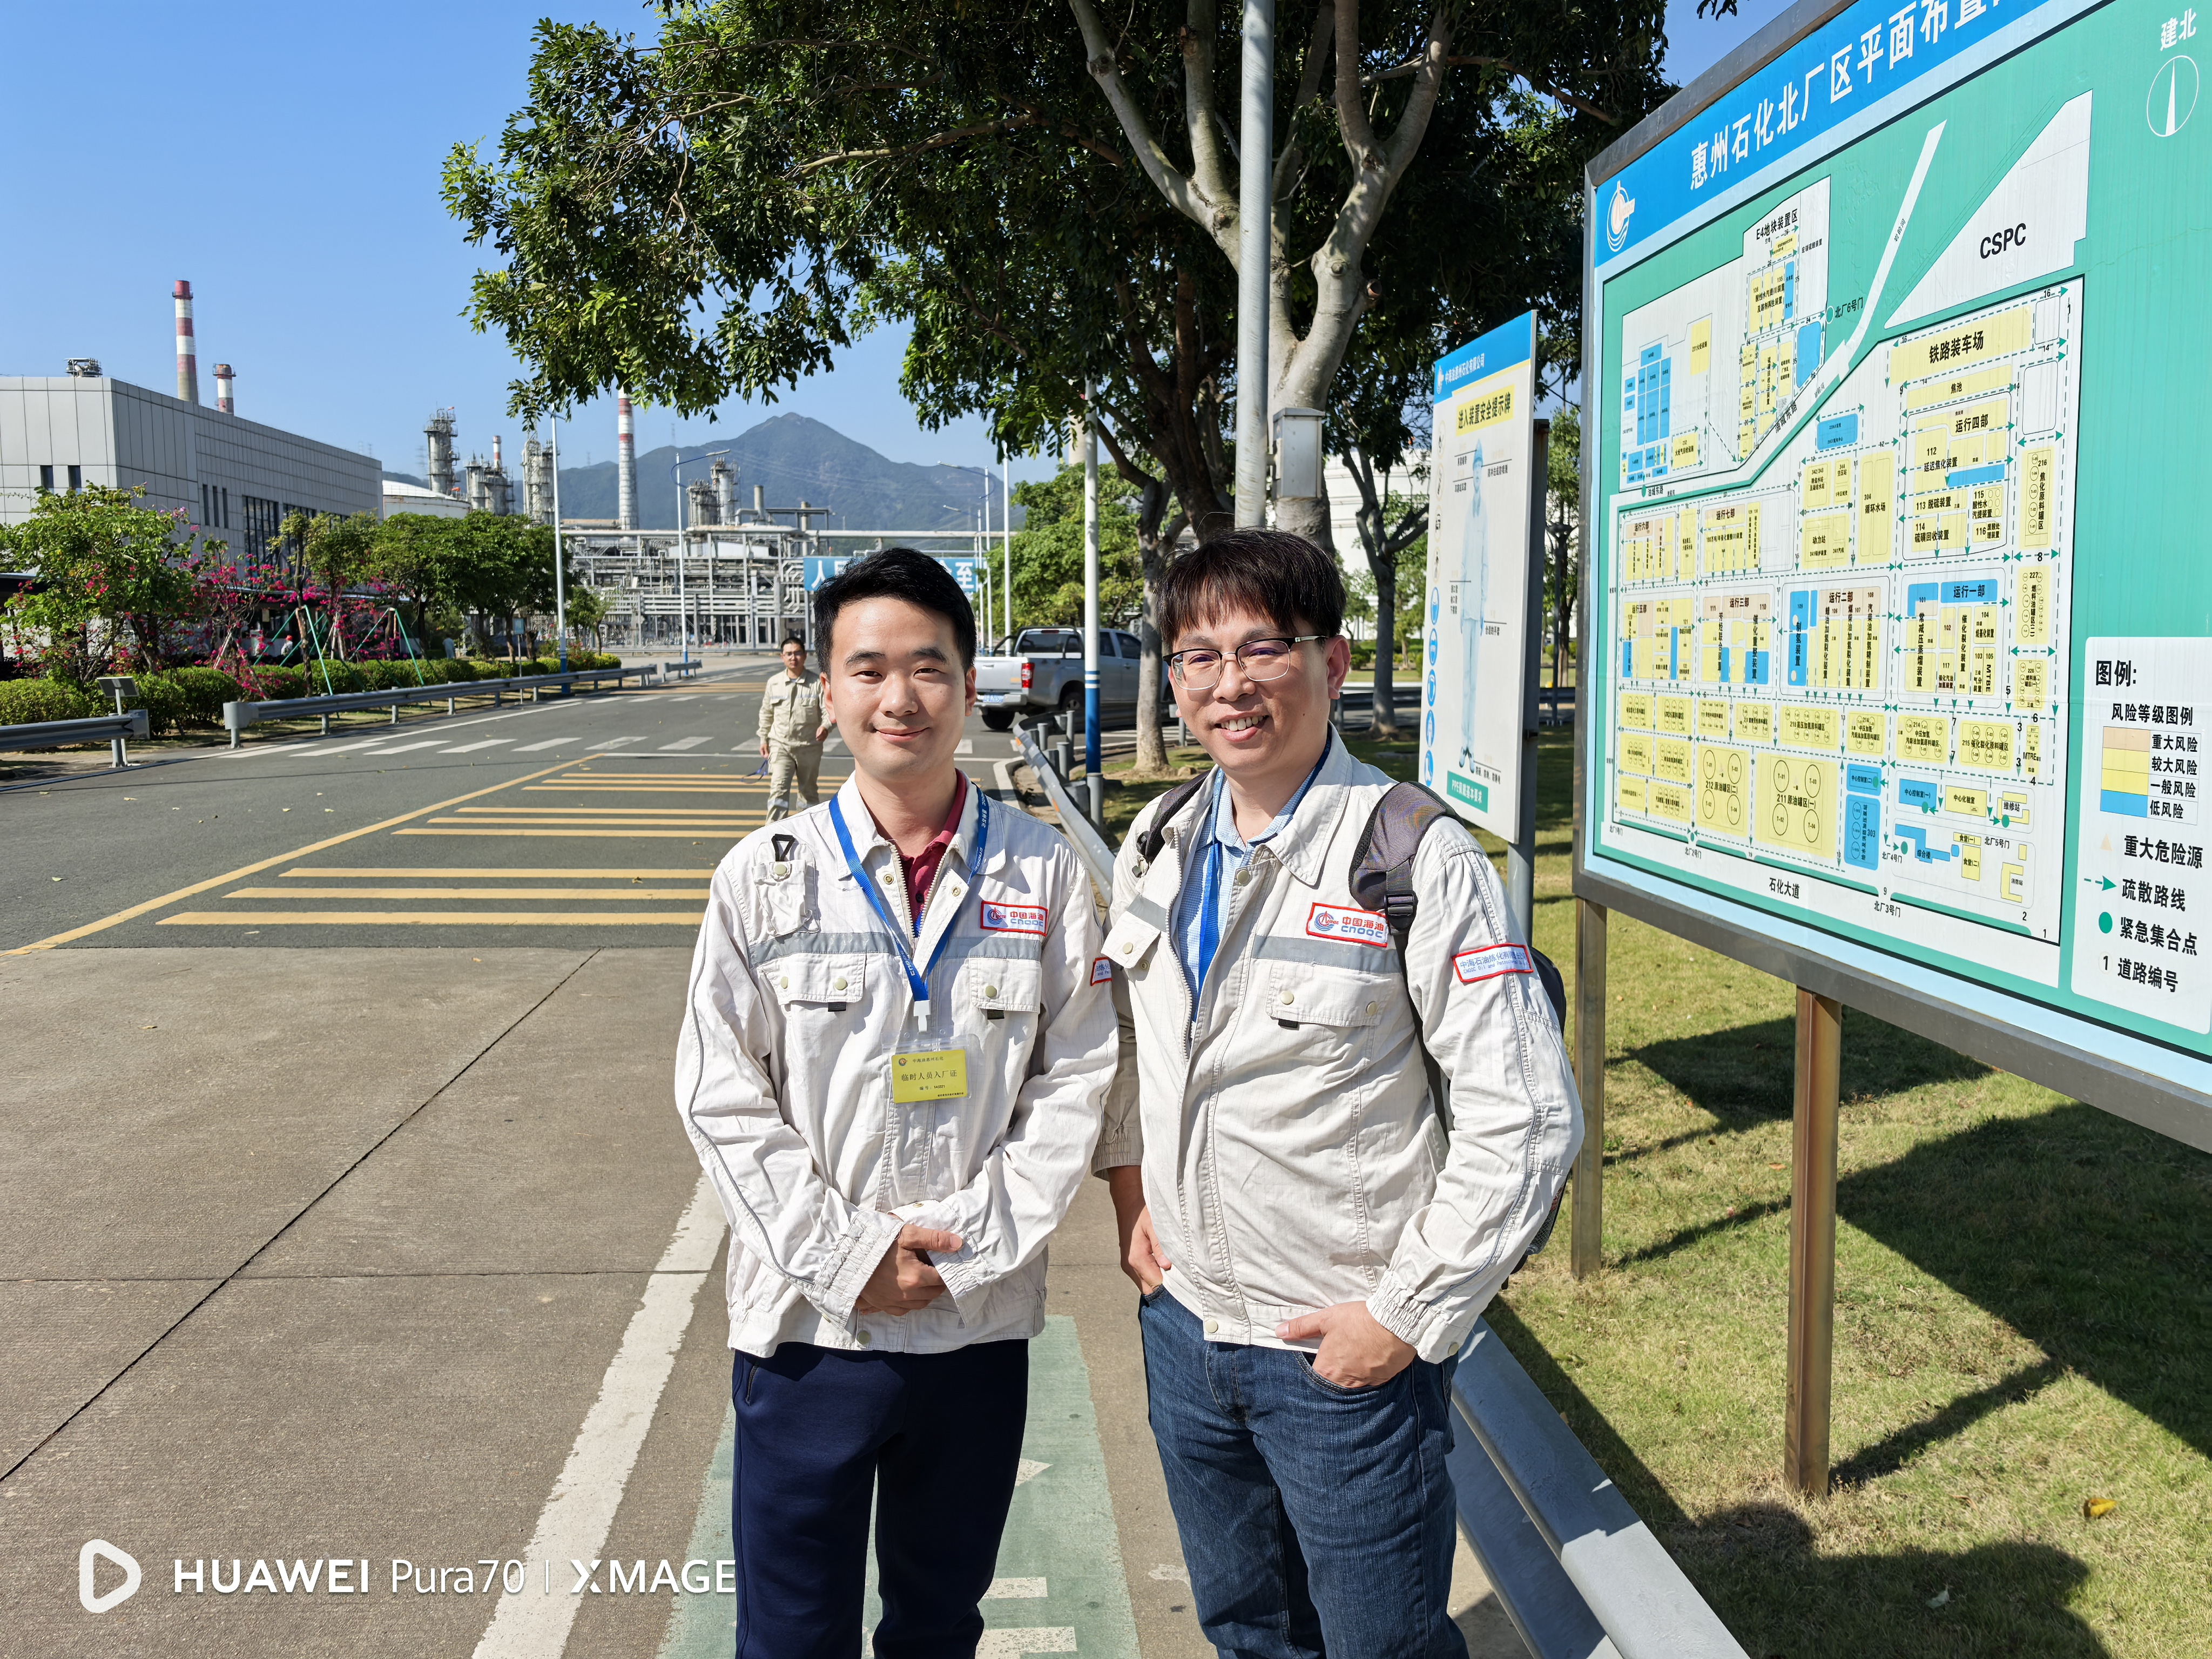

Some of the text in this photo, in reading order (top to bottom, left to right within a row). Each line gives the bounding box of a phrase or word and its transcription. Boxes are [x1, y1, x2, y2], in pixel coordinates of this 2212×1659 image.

[2160, 8, 2196, 51] 建北
[1690, 0, 1999, 191] 惠州石化北厂区平面布
[1756, 208, 1798, 240] E4地块装置区
[1980, 224, 2027, 260] CSPC
[2044, 289, 2051, 298] 16
[1835, 296, 1864, 319] 北厂6号门
[1930, 331, 1984, 364] 铁路装车场
[2042, 344, 2049, 352] 14
[1951, 381, 1963, 394] 焦池
[2013, 382, 2020, 390] 14
[1955, 413, 1989, 433] 运行四部
[1927, 447, 1937, 456] 112
[1924, 457, 1958, 472] 延迟焦化装置
[1974, 491, 1984, 499] 115
[2038, 471, 2046, 530] 焦化原料罐区
[1865, 502, 1886, 514] 循环水场
[1916, 496, 1951, 510] 113 脱硫装置
[1972, 499, 1987, 509] 酸性水
[1716, 508, 1735, 520] 运行七部
[1972, 509, 1992, 519] 汽提装置
[1916, 523, 1925, 531] 114
[1976, 527, 1986, 535] 116
[1812, 535, 1826, 544] 动力站
[1914, 529, 1949, 543] 硫磺回收装置
[2037, 551, 2042, 562] 8
[1829, 591, 1853, 603] 运行二部
[1953, 584, 1985, 598] 运行一部
[1632, 604, 1647, 613] 运行五部
[1730, 597, 1749, 608] 运行三部
[1916, 612, 1925, 687] 常减压蒸馏装置
[2006, 685, 2011, 695] 5
[2033, 713, 2038, 723] 6
[2112, 704, 2193, 726] 风险等级图例
[1952, 717, 1957, 726] 7
[2017, 722, 2022, 732] 3
[1915, 730, 1930, 738] 中压加氢
[1971, 739, 2009, 751] 催化裂化原料罐区
[2152, 734, 2198, 753] 重大风险
[1951, 751, 1955, 759] 7
[2016, 758, 2021, 767] 3
[2152, 756, 2197, 775] 较大风险
[1851, 775, 1872, 784] 中心控制室(二)
[2031, 777, 2036, 785] 4
[1714, 781, 1738, 794] 原油罐区(二)
[1904, 788, 1931, 799] 中心控制室(一)
[2150, 778, 2196, 798] 一般风险
[1777, 794, 1816, 810] 211 原油罐区(一)
[1953, 794, 1975, 805] 中心化验室
[2003, 801, 2020, 812] 维修站
[2150, 800, 2183, 819] 低风险
[1867, 829, 1876, 838] 303
[1959, 834, 1975, 844] 食堂(一)
[1985, 836, 2010, 849] 北厂5号门
[1684, 847, 1701, 860] 北厂2号门
[1881, 851, 1903, 864] 北厂4号门
[1917, 849, 1931, 860] 综合楼
[2124, 835, 2203, 869] 重大危险源
[1964, 858, 1979, 868] 食堂(二)
[1769, 877, 1800, 899] 石化大道
[1884, 887, 1887, 895] 9
[2122, 879, 2186, 911] 疏散路线
[1874, 901, 1901, 918] 北厂3号门
[1010, 911, 1043, 921] 中国海油
[2022, 911, 2027, 921] 2
[1342, 916, 1384, 931] 中国海油
[2043, 928, 2047, 939] 1
[2120, 916, 2198, 956] 紧急集合点
[2103, 954, 2179, 993] 1 道路编号
[901, 1069, 957, 1082] 临时人员入厂证
